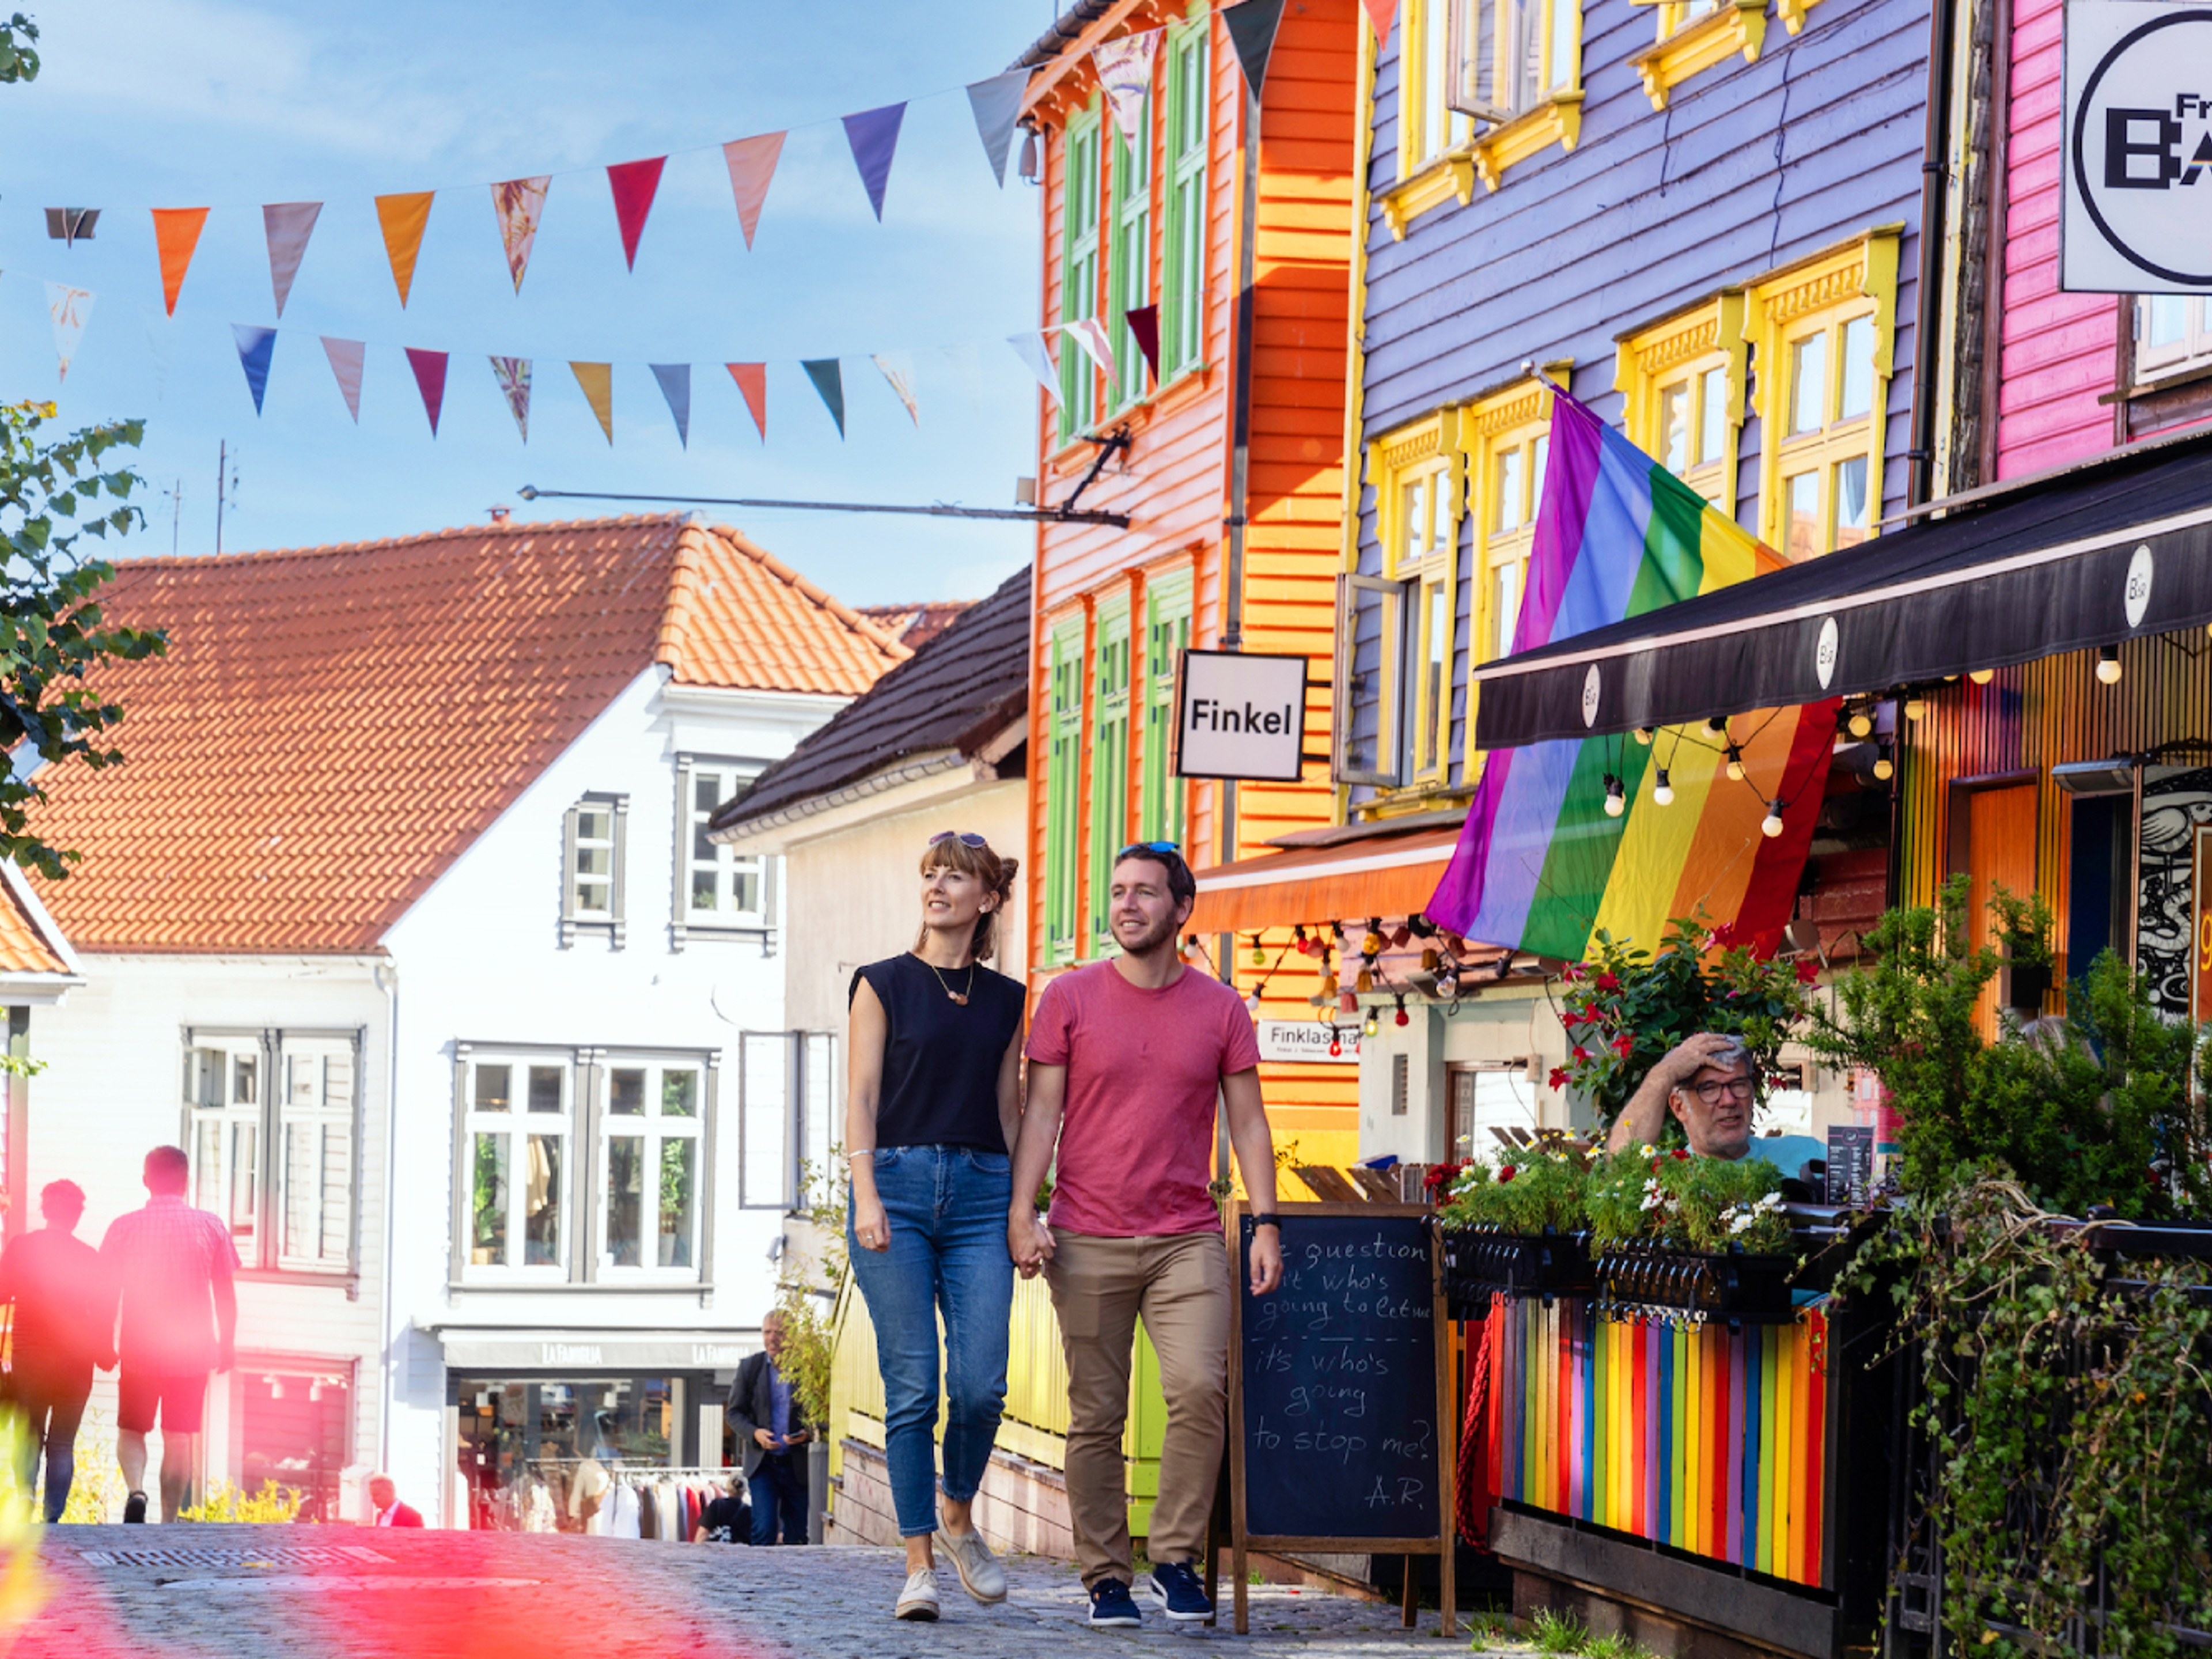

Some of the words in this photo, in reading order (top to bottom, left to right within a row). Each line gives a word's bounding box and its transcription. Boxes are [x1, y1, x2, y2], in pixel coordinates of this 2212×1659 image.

[1191, 699, 1291, 735] Finkel
[1305, 1232, 1426, 1270] question
[1323, 1264, 1389, 1291] who's
[1256, 1300, 1332, 1331] going
[1343, 1292, 1368, 1313] to
[1255, 1343, 1291, 1373] it's
[1311, 1345, 1389, 1375] who's
[1284, 1384, 1368, 1417] going
[1252, 1415, 1281, 1449] to
[1293, 1419, 1367, 1465] stop
